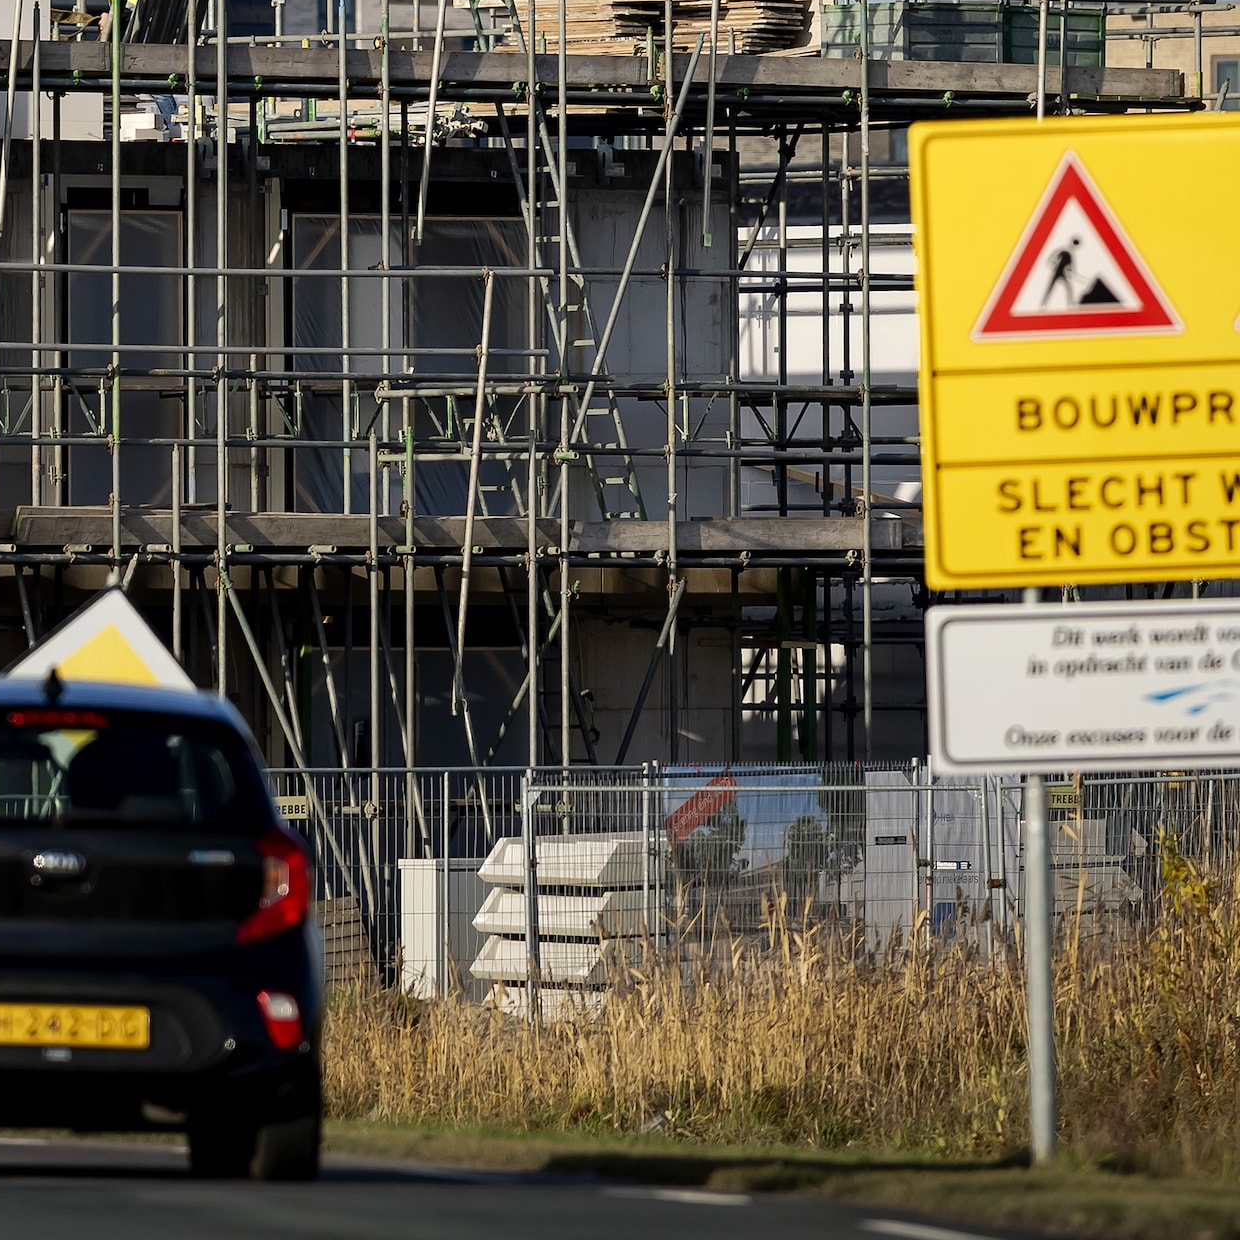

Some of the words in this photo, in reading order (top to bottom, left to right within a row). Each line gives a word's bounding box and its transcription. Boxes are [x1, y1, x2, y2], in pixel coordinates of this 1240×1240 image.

[1018, 392, 1234, 430] BOUWPR
[998, 472, 1195, 512] SLECHT
[1220, 471, 1240, 503] W
[1020, 527, 1081, 559] EN
[1111, 519, 1240, 555] OBST
[275, 805, 306, 815] REBBE
[1051, 794, 1079, 804] TREBB
